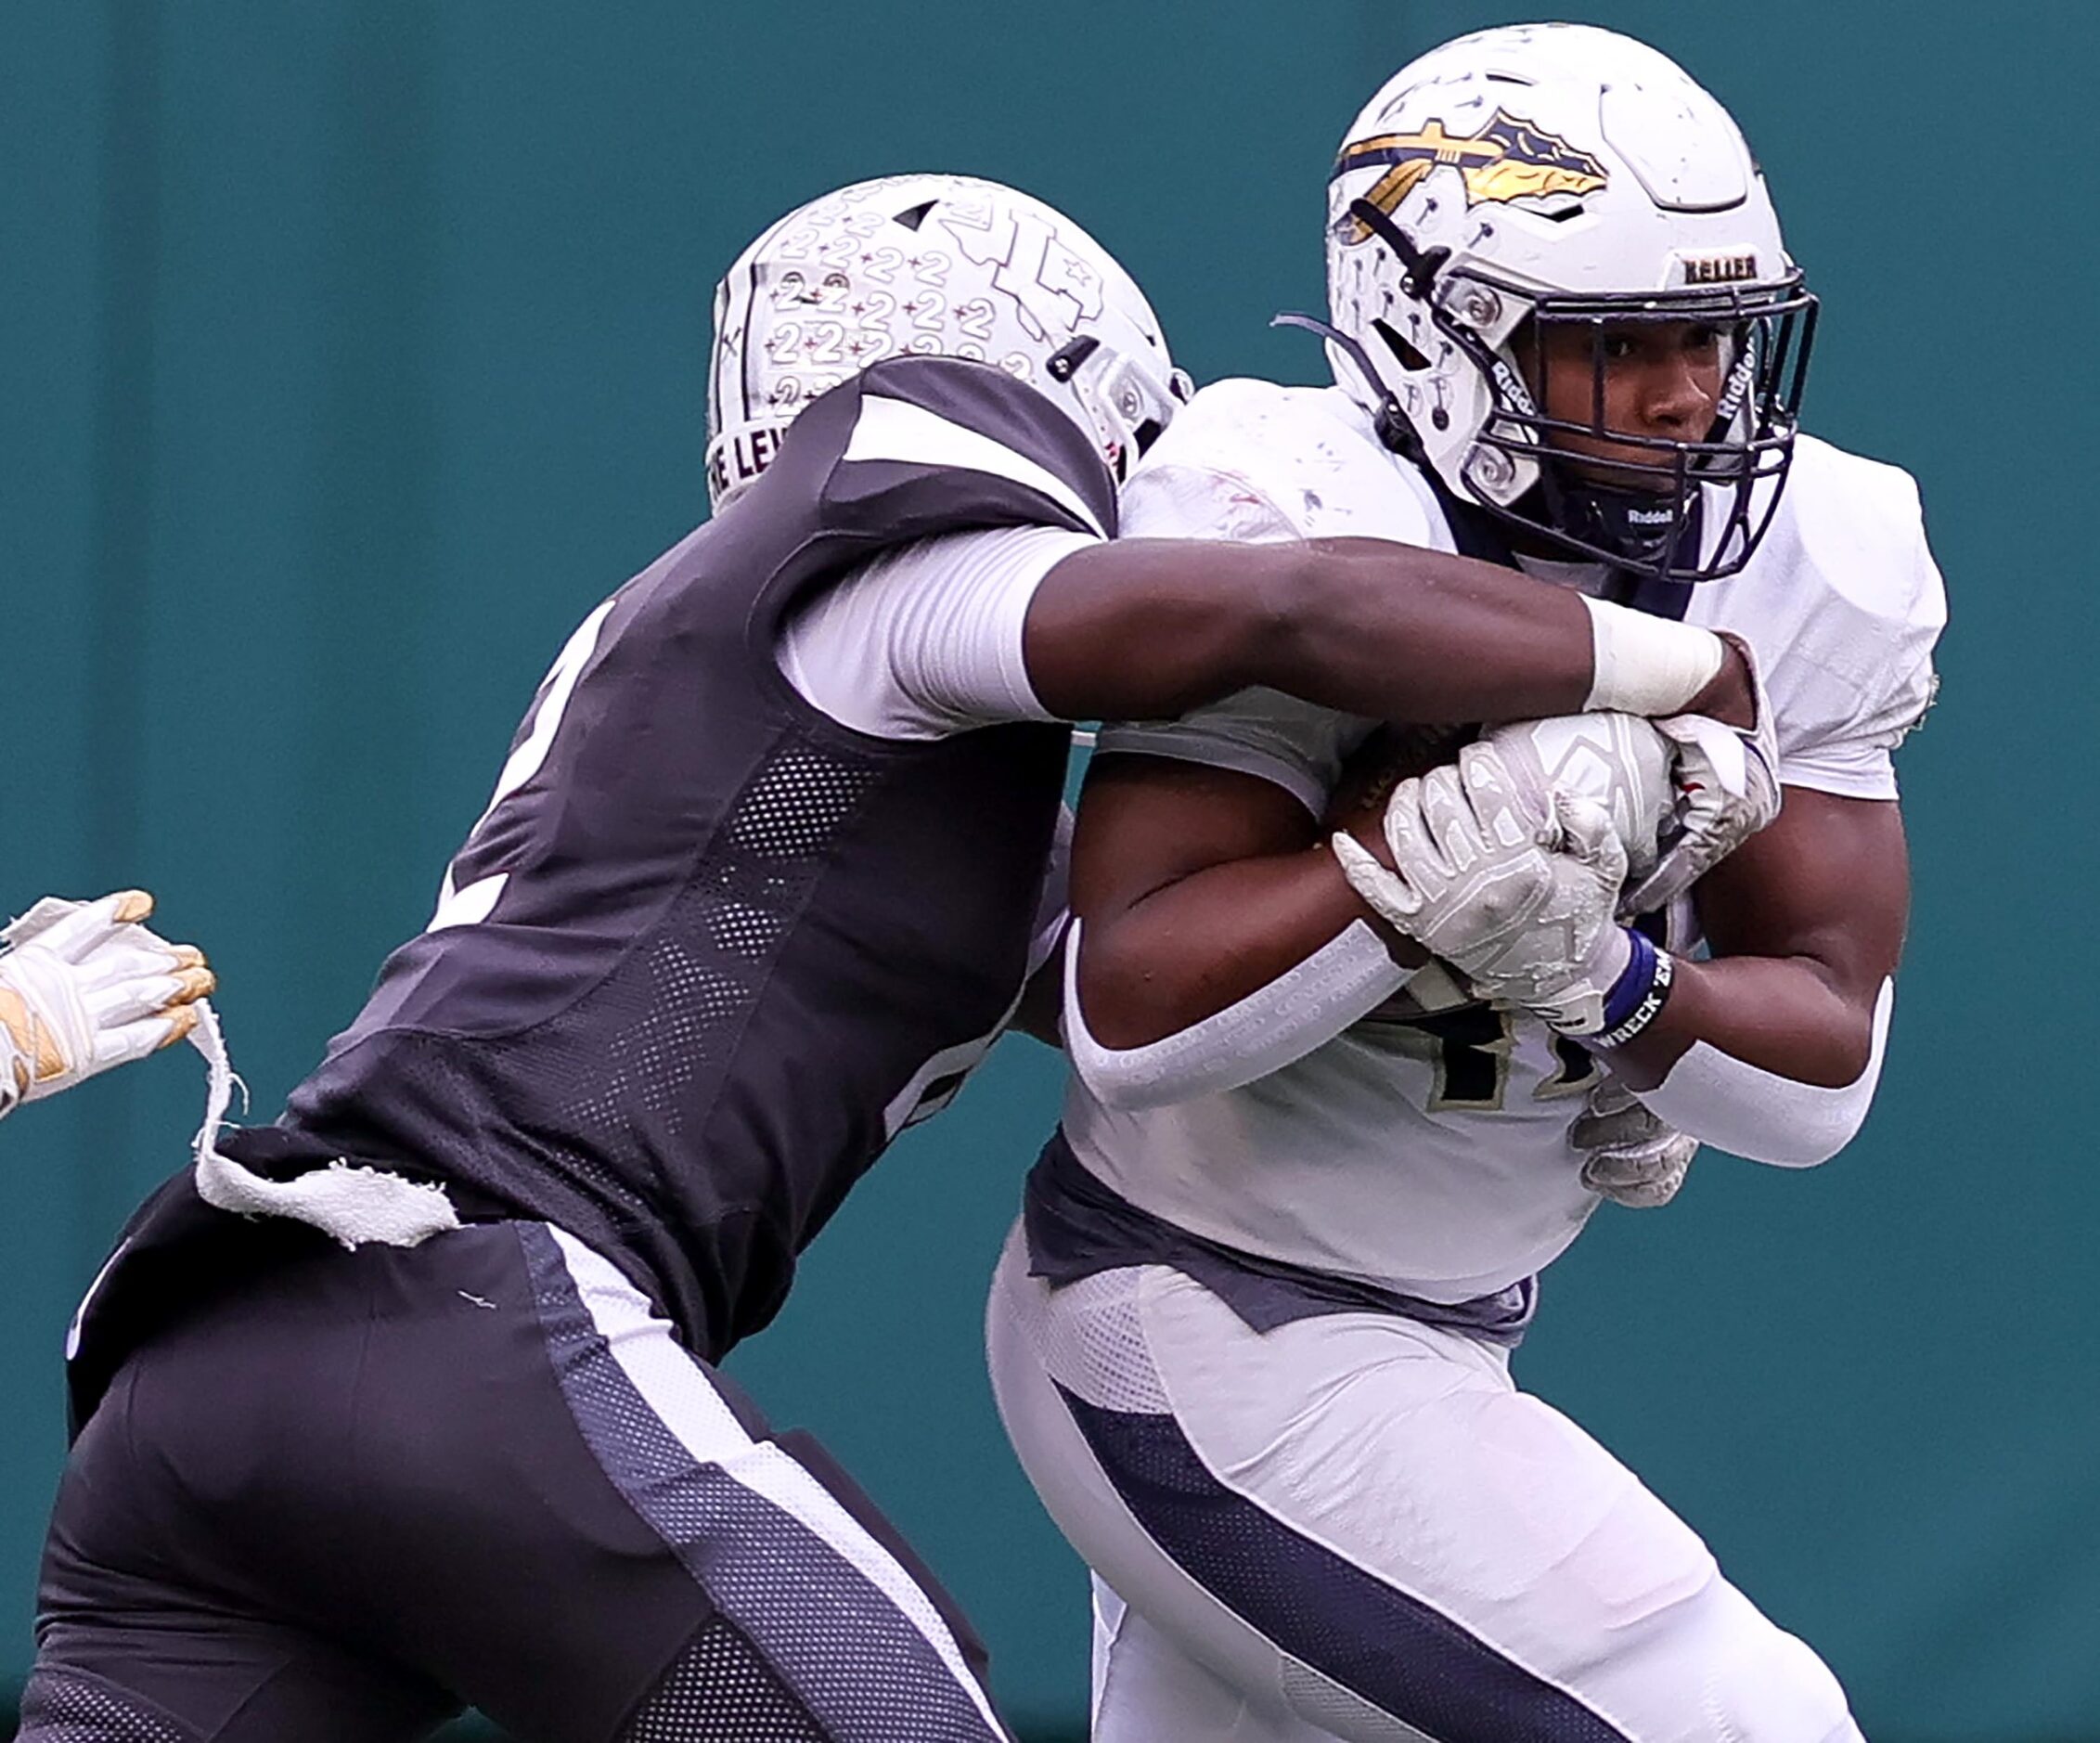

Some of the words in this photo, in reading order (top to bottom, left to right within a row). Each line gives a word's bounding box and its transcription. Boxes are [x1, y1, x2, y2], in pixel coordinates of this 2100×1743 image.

[1683, 255, 1757, 284] KELLER
[1628, 509, 1674, 524] Riddell
[1592, 992, 1663, 1049] WRECK
